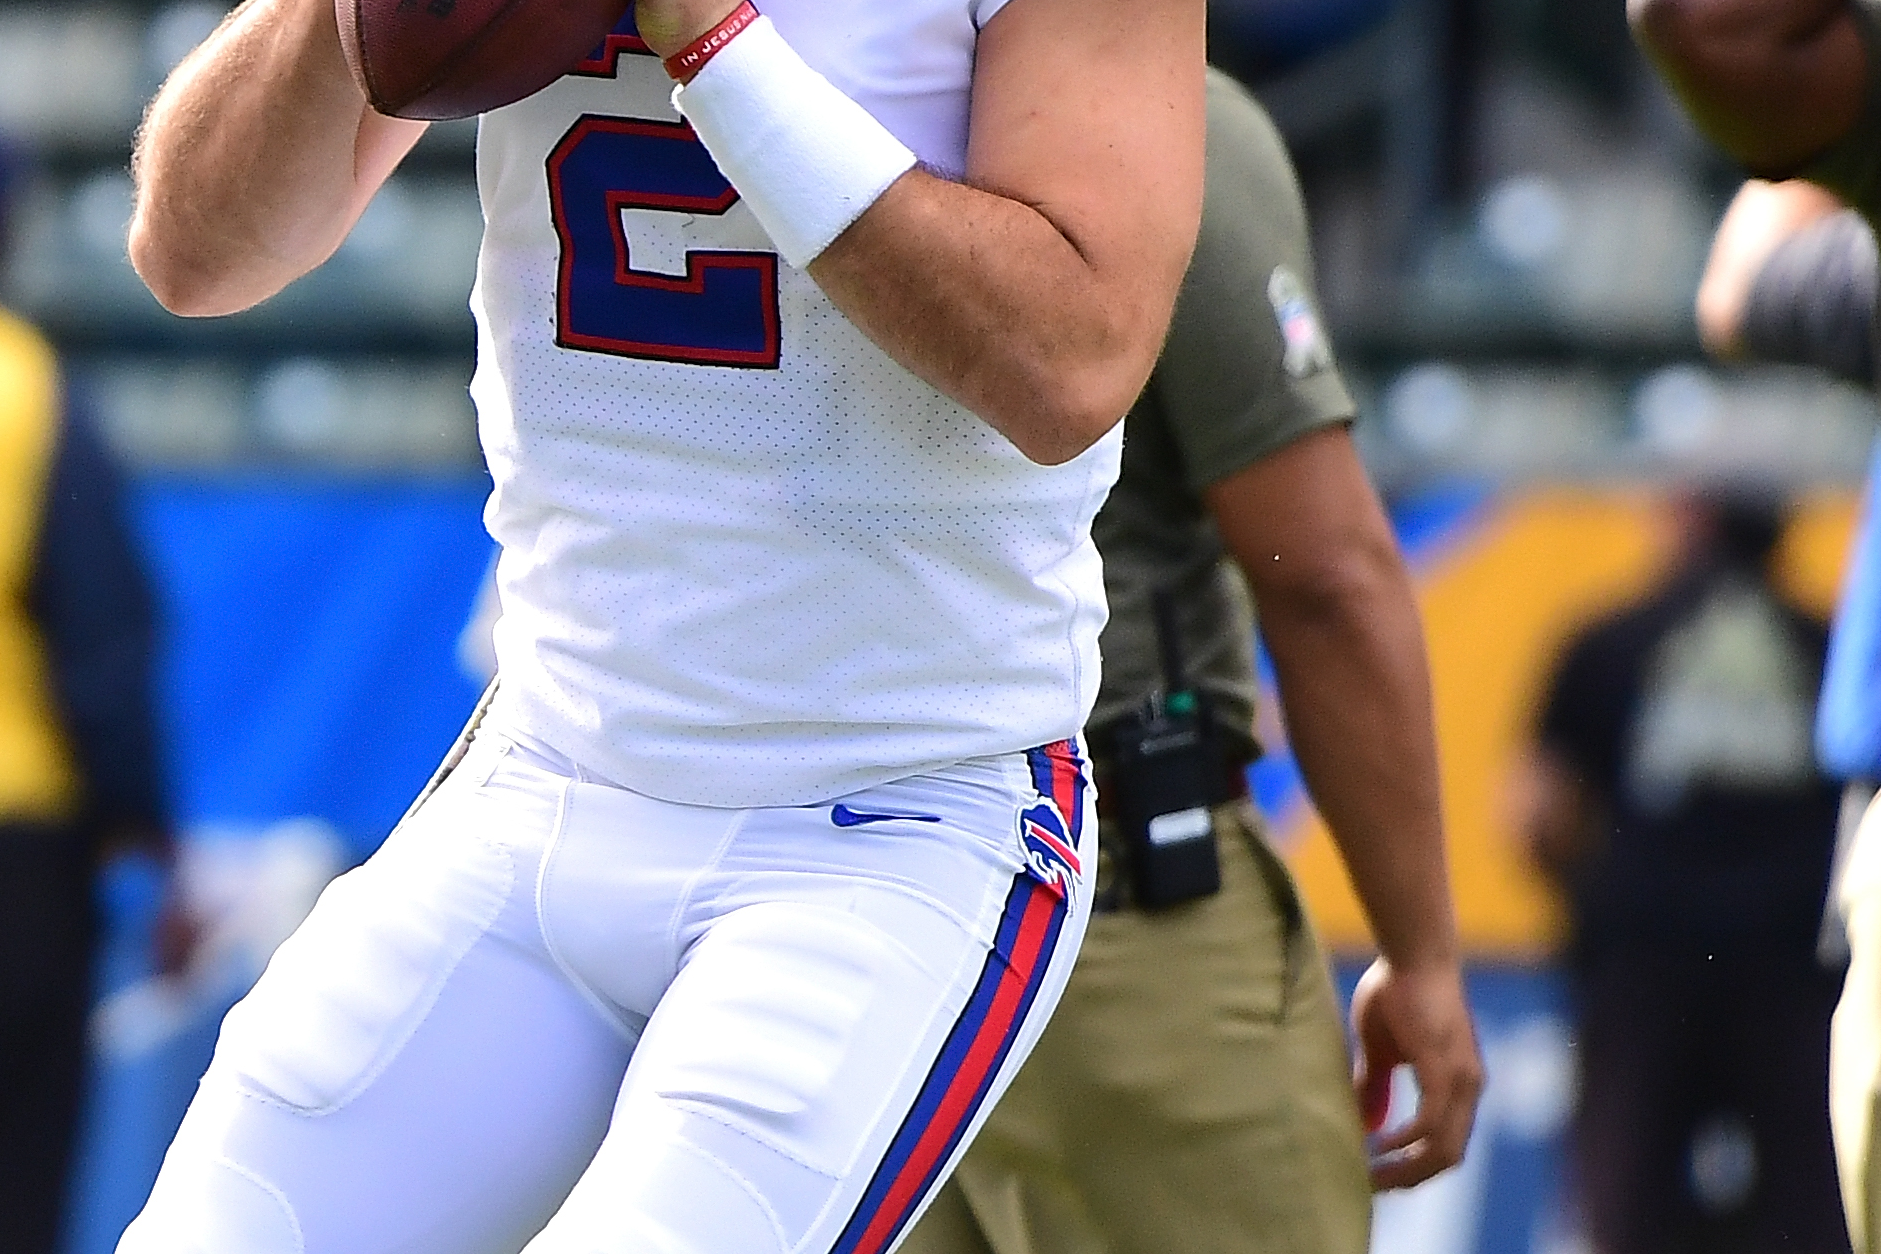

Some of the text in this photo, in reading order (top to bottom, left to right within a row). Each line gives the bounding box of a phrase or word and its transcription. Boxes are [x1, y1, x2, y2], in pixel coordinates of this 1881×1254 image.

[681, 51, 698, 67] IN
[702, 19, 741, 53] JESUS
[545, 3, 782, 370] 2
